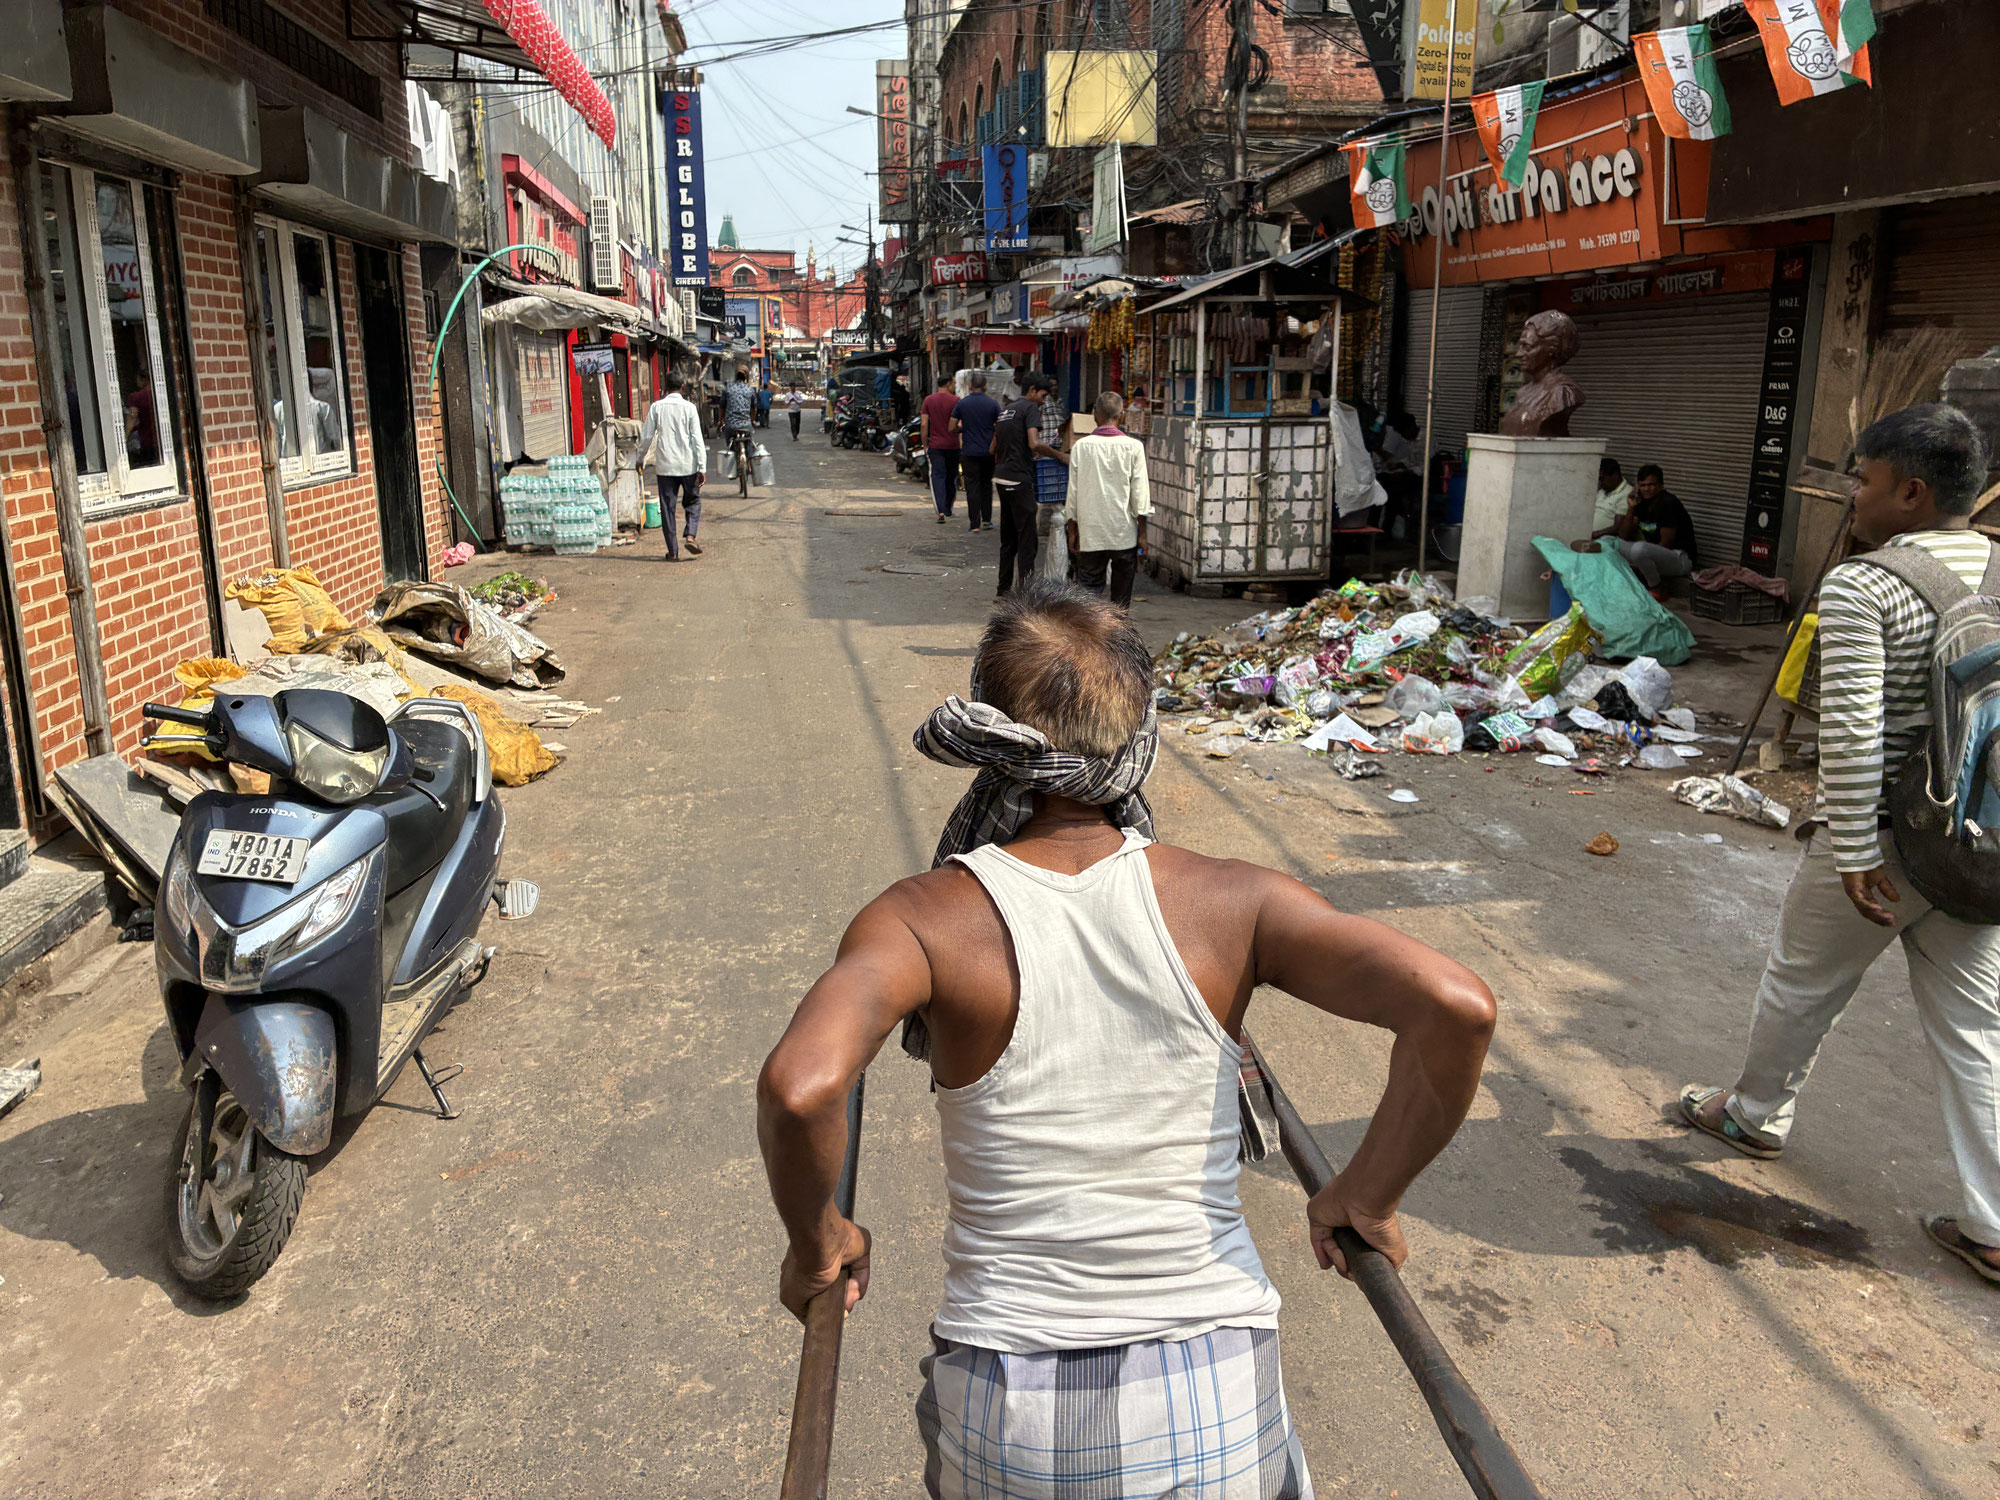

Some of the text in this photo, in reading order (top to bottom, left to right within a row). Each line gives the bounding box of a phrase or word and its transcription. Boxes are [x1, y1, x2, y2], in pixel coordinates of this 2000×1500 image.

[1419, 77, 1466, 88] availble
[678, 165, 697, 273] GLOBE
[1764, 405, 1787, 421] D&G
[250, 807, 298, 819] HONDA
[228, 833, 294, 859] WB01A
[219, 853, 288, 879] J7852
